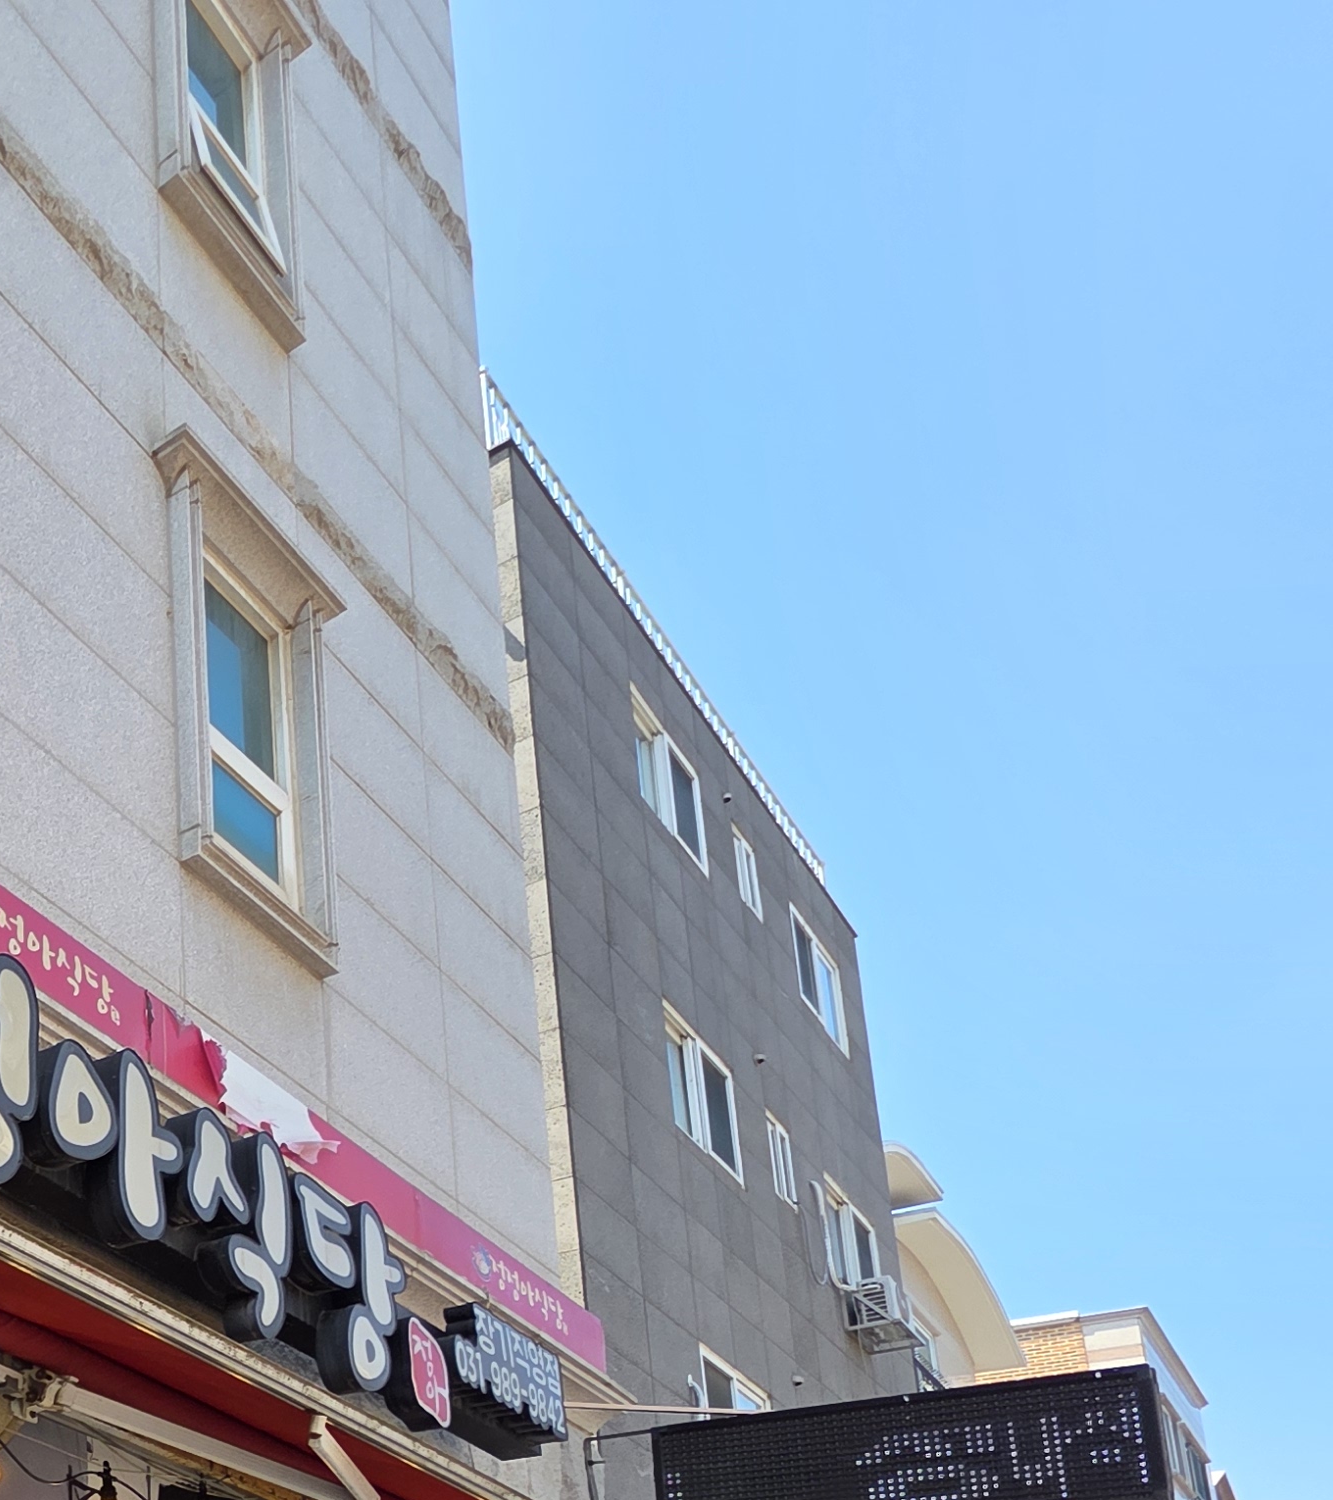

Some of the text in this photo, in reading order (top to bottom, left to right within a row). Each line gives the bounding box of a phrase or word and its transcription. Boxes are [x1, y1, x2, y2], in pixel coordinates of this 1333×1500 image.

[412, 1334, 448, 1416] 정아
[455, 1340, 566, 1435] 031 989-9842
[474, 1306, 562, 1397] 장기직영점
